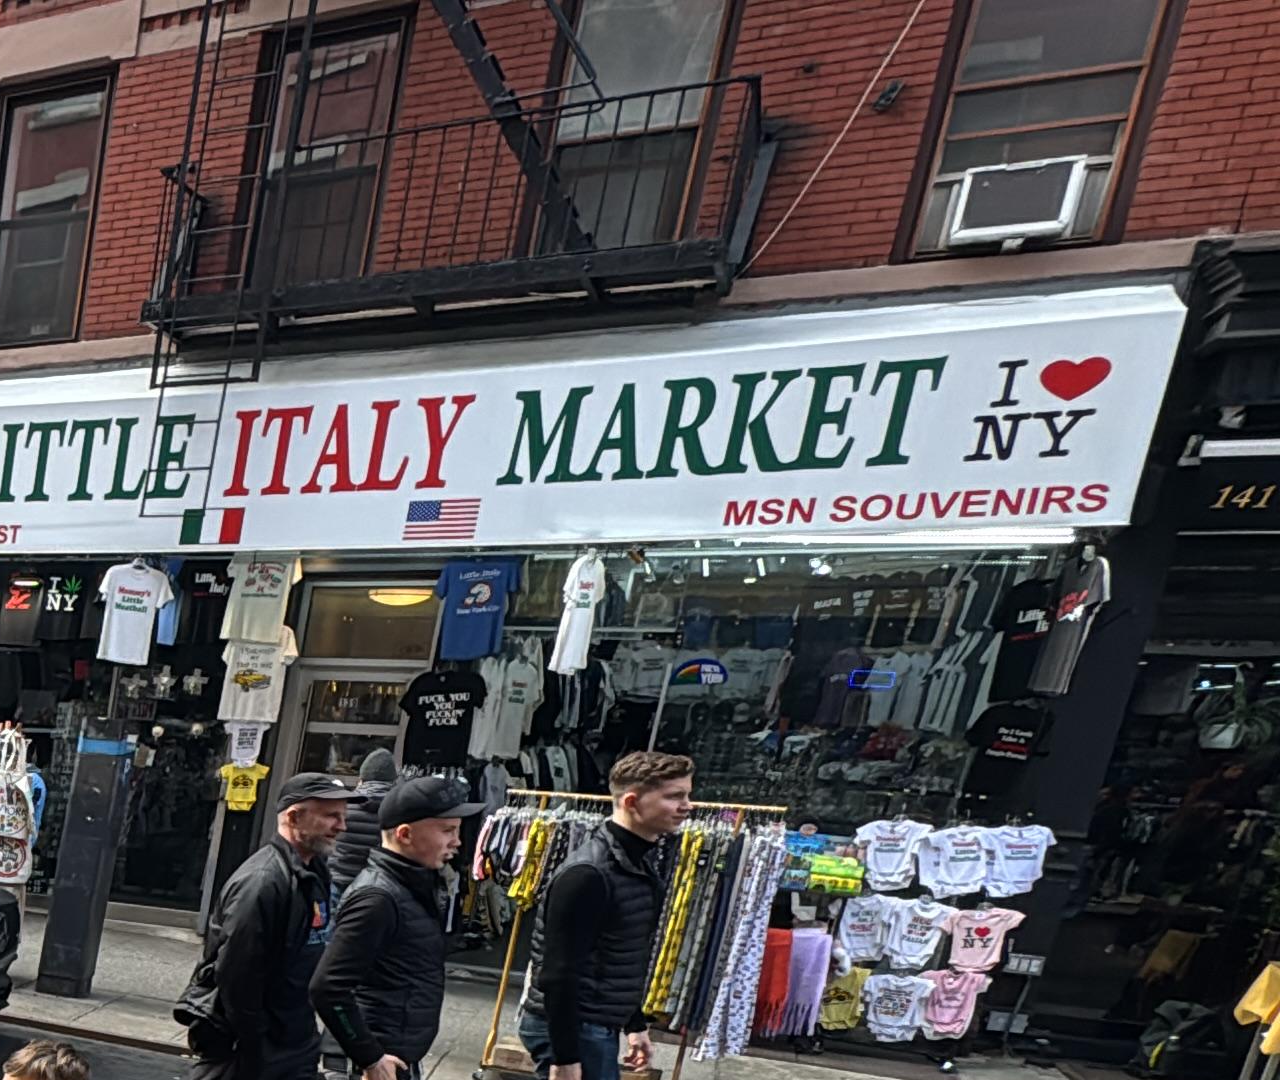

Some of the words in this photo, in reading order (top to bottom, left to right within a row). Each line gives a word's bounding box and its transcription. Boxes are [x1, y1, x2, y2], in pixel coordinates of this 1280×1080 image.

[989, 359, 1030, 407] I
[220, 394, 477, 498] ITALY
[495, 353, 950, 487] MARKET
[962, 408, 1097, 463] NY
[722, 496, 818, 528] MSN
[828, 482, 1111, 524] SOUVENIRS
[1208, 484, 1278, 509] 141
[49, 576, 62, 594] I
[45, 593, 79, 612] NY
[417, 694, 446, 706] FUCK
[448, 692, 471, 702] YOU
[433, 701, 456, 710] YOU
[428, 718, 459, 727] FUCK
[965, 927, 973, 938] I
[961, 938, 994, 949] NY
